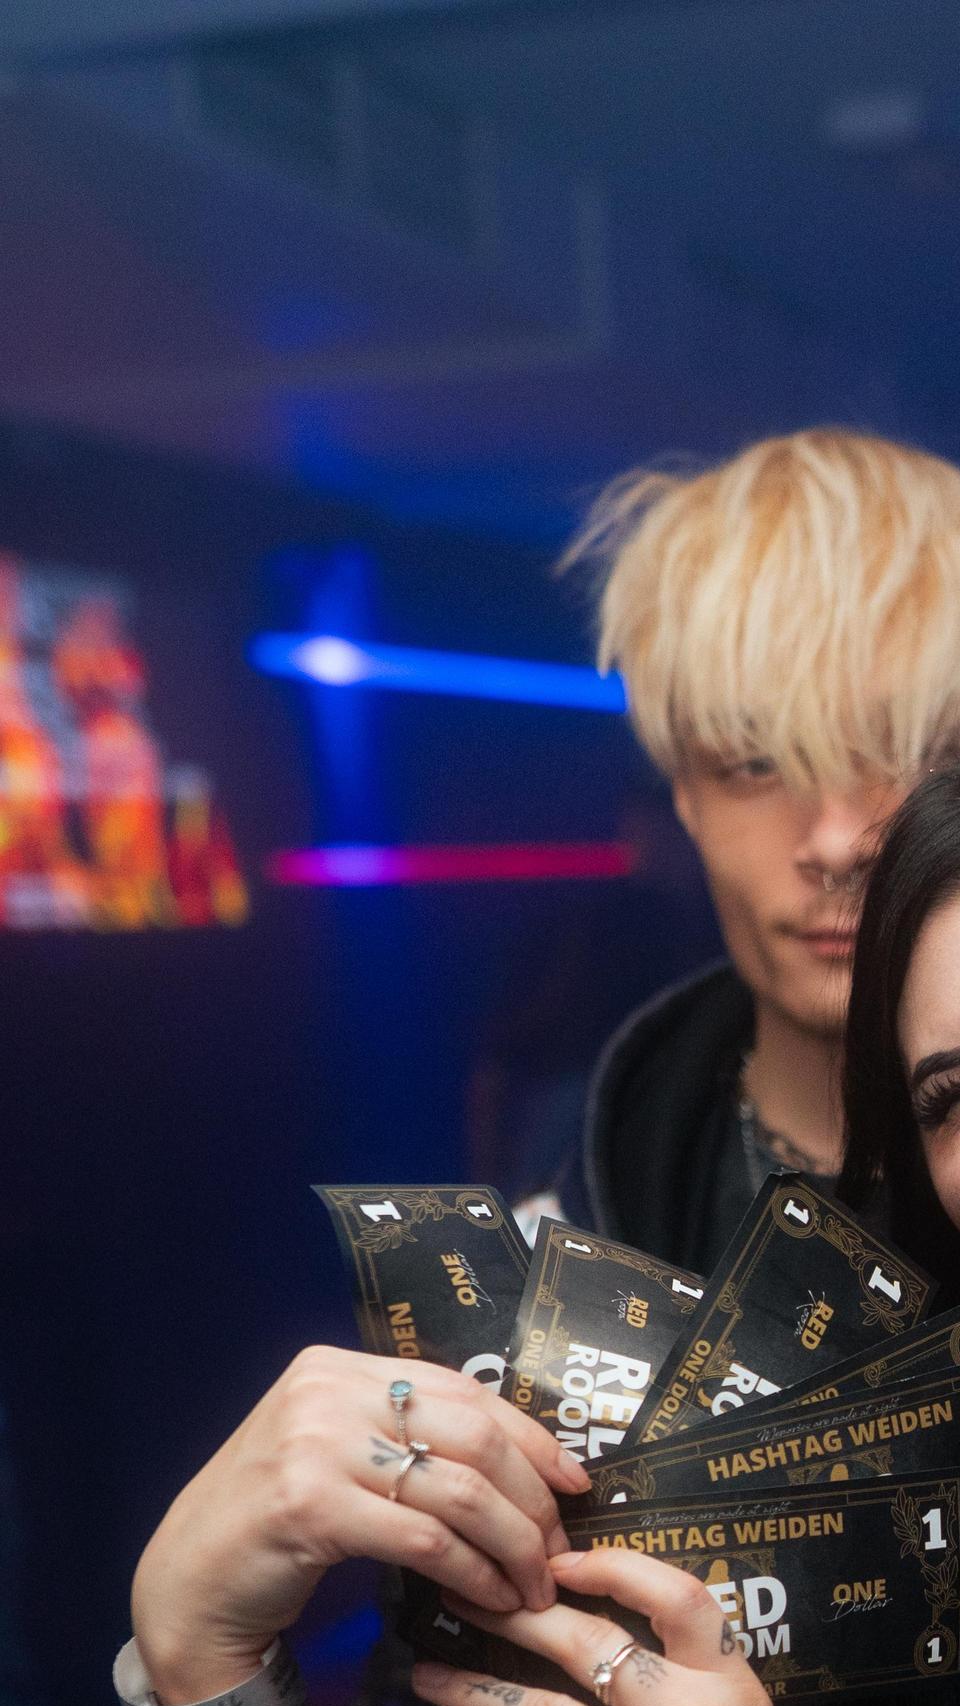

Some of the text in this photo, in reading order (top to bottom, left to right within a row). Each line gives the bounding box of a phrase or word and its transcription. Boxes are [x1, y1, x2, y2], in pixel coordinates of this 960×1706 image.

[359, 1200, 402, 1222] 1
[467, 1203, 493, 1219] 1
[784, 1199, 809, 1224] 1
[564, 1240, 591, 1253] 1
[440, 1253, 478, 1306] ONE
[672, 1278, 704, 1300] 1
[868, 1265, 902, 1303] 1
[387, 1302, 420, 1358] DEN
[626, 1296, 649, 1329] RED
[802, 1300, 834, 1350] RED
[523, 1329, 546, 1370] ONE
[642, 1339, 712, 1444] ONE DOLLA
[707, 1400, 953, 1482] HASHTAG WEIDEN
[592, 1512, 844, 1554] HASHTAG WEIDEN
[921, 1508, 947, 1550] 1
[706, 1575, 788, 1631] ED
[832, 1578, 887, 1602] ONE
[735, 1624, 791, 1660] OM
[926, 1637, 942, 1663] 1
